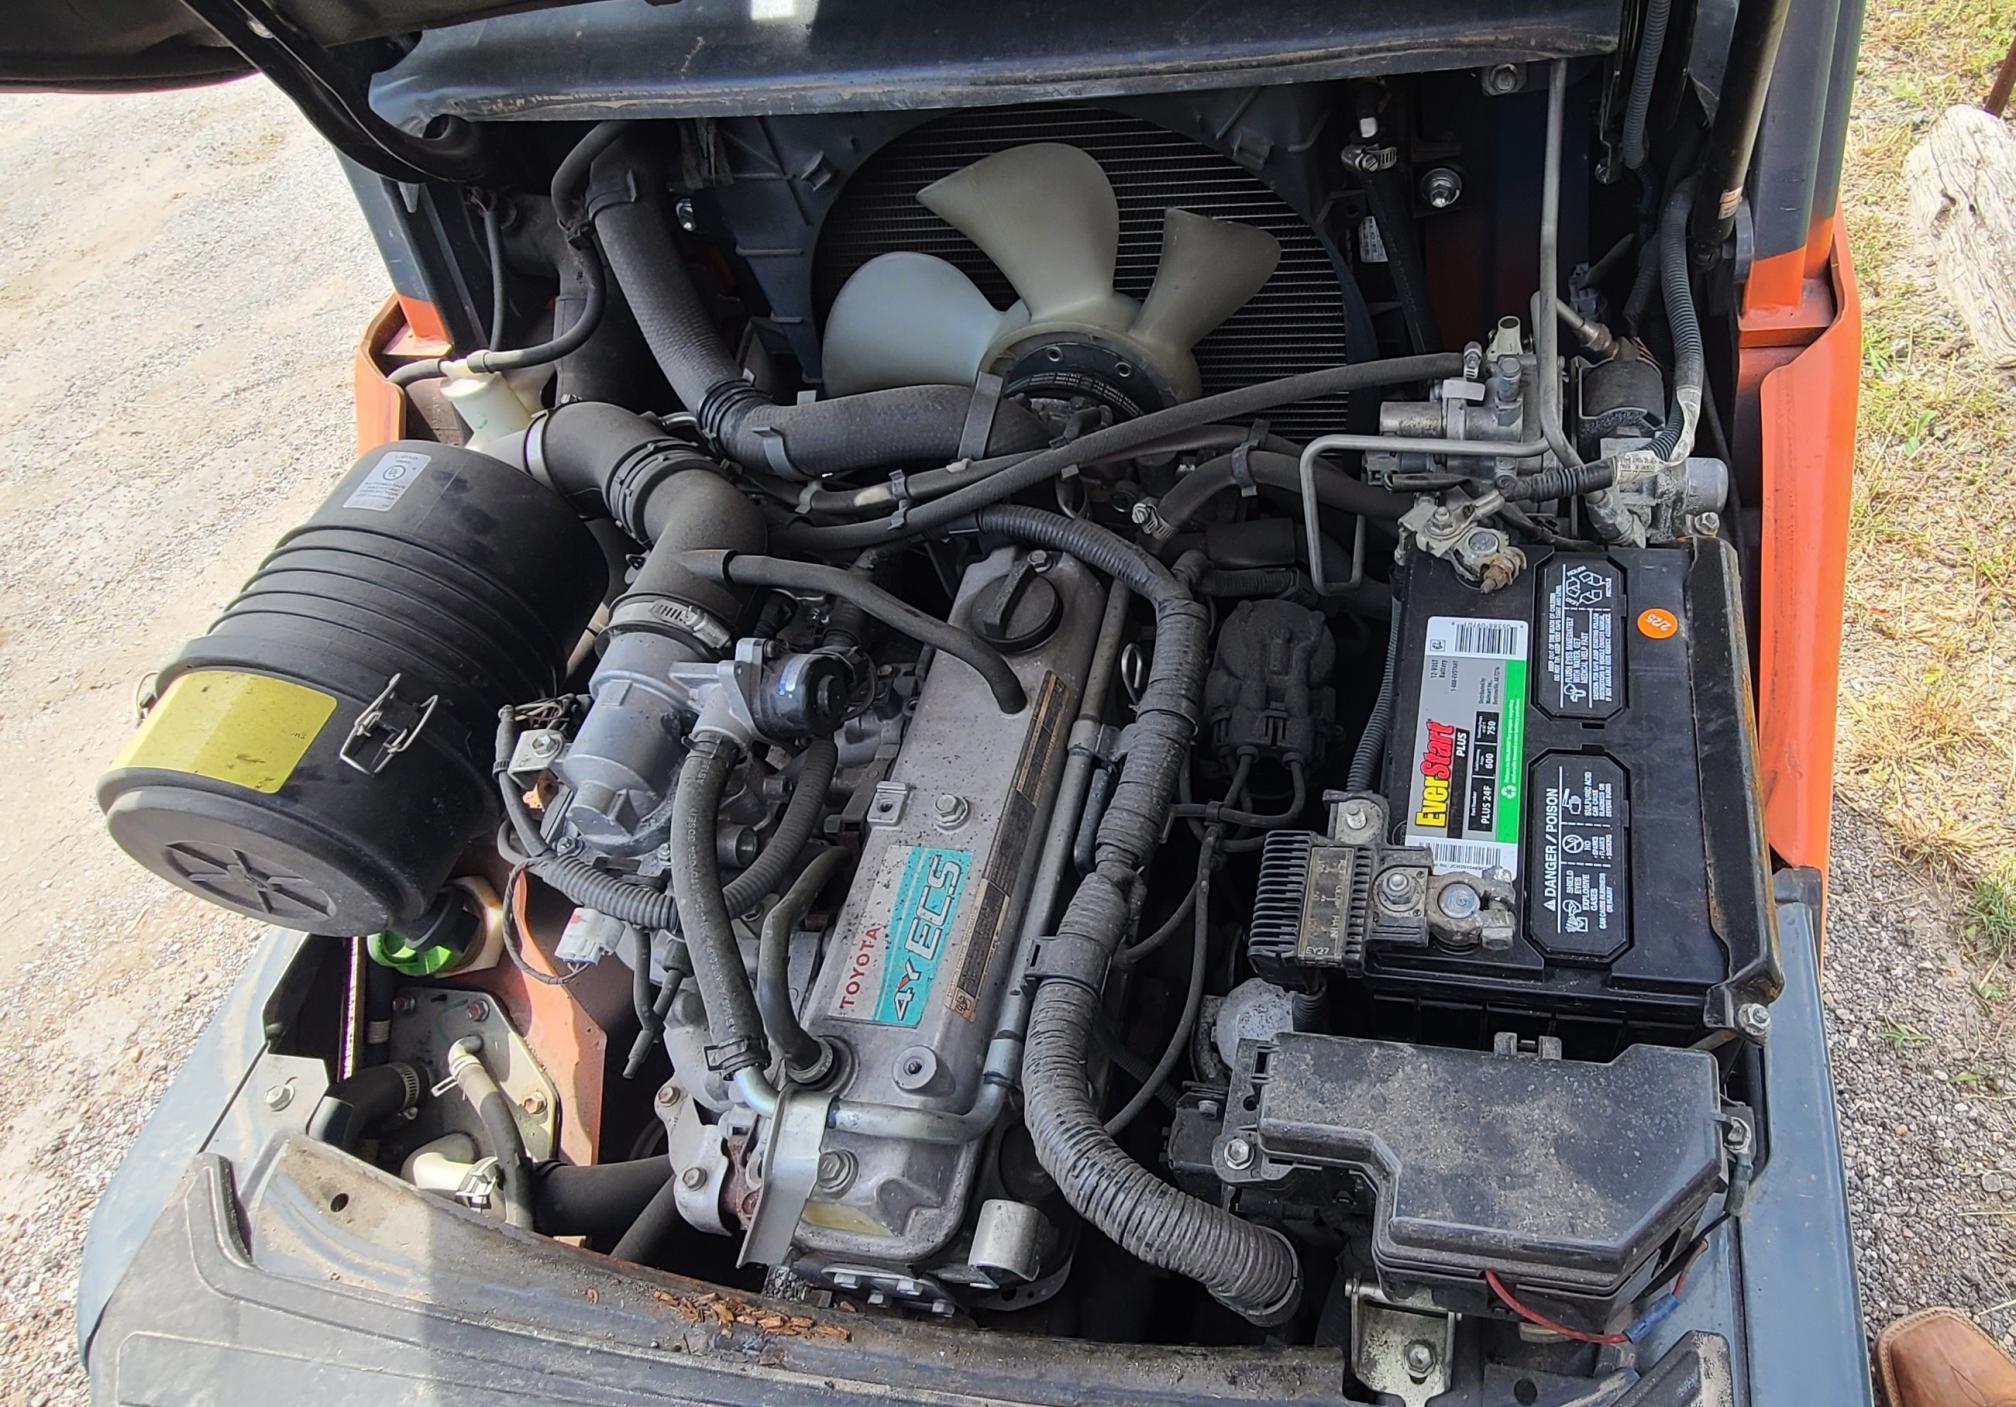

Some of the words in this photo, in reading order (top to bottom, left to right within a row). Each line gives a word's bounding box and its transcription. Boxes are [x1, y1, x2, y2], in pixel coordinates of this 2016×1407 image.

[1566, 616, 1574, 650] IMMEDIATELY
[1565, 651, 1573, 665] EYES
[1565, 666, 1573, 683] FLUSH
[1487, 720, 1497, 736] 750
[1456, 731, 1467, 757] PLUS
[1485, 753, 1494, 770] 600
[1415, 720, 1454, 827] EverStart
[1484, 785, 1493, 802] 24F
[1584, 786, 1592, 816] SULFURIC
[1480, 803, 1491, 824] PLUS
[1584, 840, 1591, 850] NO
[1566, 870, 1574, 894] SHIELD
[1574, 876, 1582, 894] EYES
[1582, 874, 1590, 910] EXPLOSIVE
[903, 854, 961, 961] ECS
[1590, 888, 1598, 911] GASES
[1306, 945, 1330, 955] EY27
[839, 927, 881, 1009] TOYOTA
[893, 957, 921, 1022] 4Y
